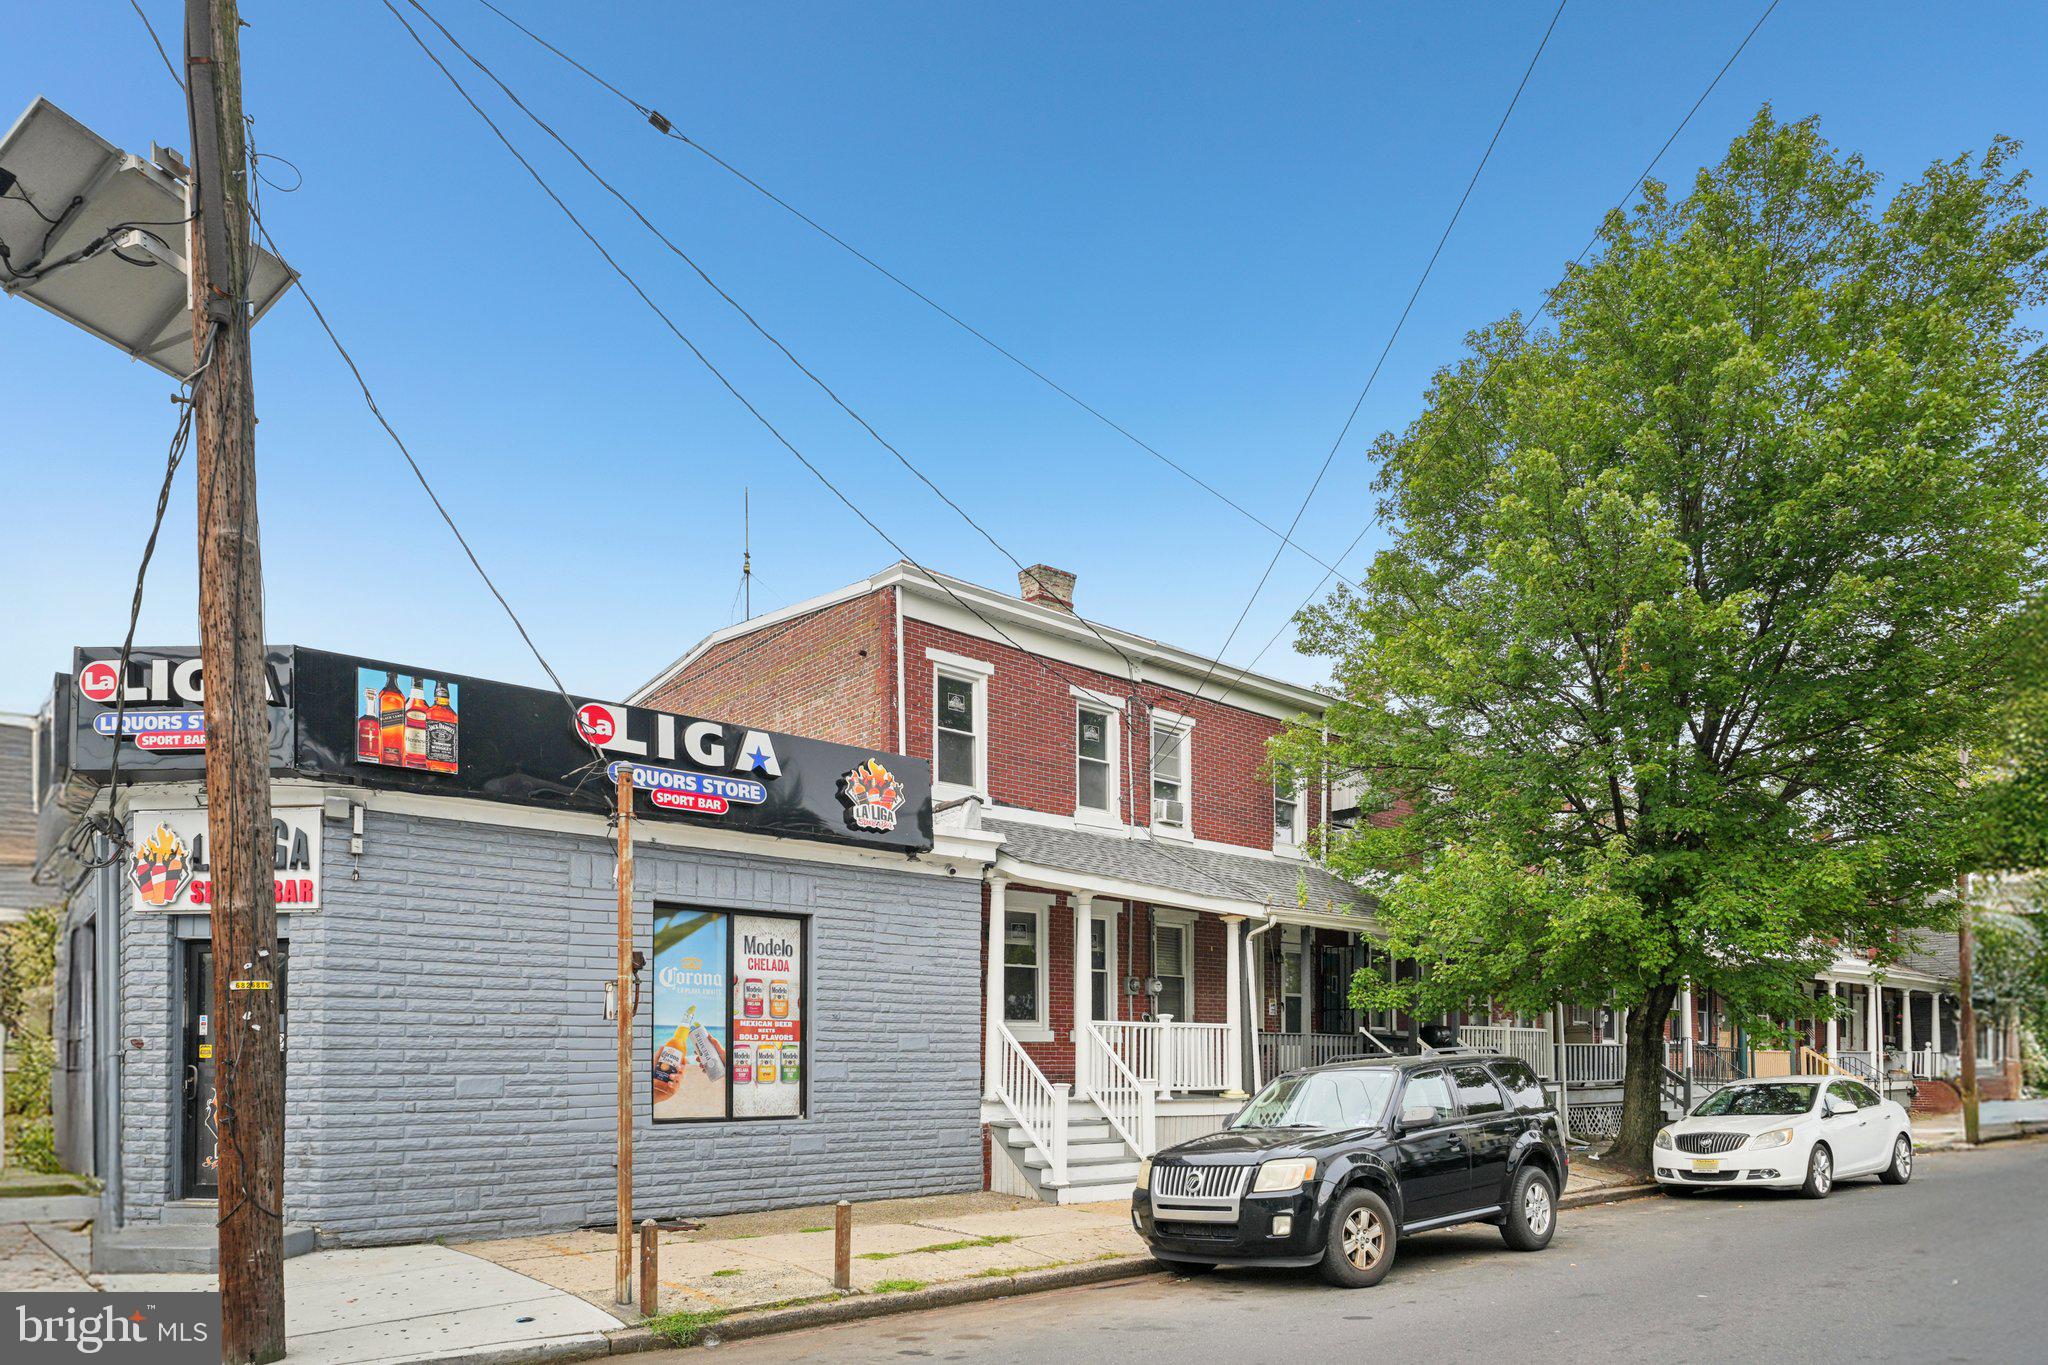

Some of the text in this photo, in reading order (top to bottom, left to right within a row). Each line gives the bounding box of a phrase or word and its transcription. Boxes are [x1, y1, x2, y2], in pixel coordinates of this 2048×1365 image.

[85, 672, 115, 691] La
[100, 715, 182, 733] LIQUORS
[581, 711, 613, 737] La
[142, 735, 181, 746] SPORT
[610, 706, 782, 777] LIGA
[614, 764, 761, 800] QUORS STORE
[657, 792, 721, 810] SPORT BAR
[871, 805, 894, 823] LIGA
[744, 935, 793, 958] Modelo
[747, 957, 790, 972] CHELADA
[659, 966, 722, 990] Corona
